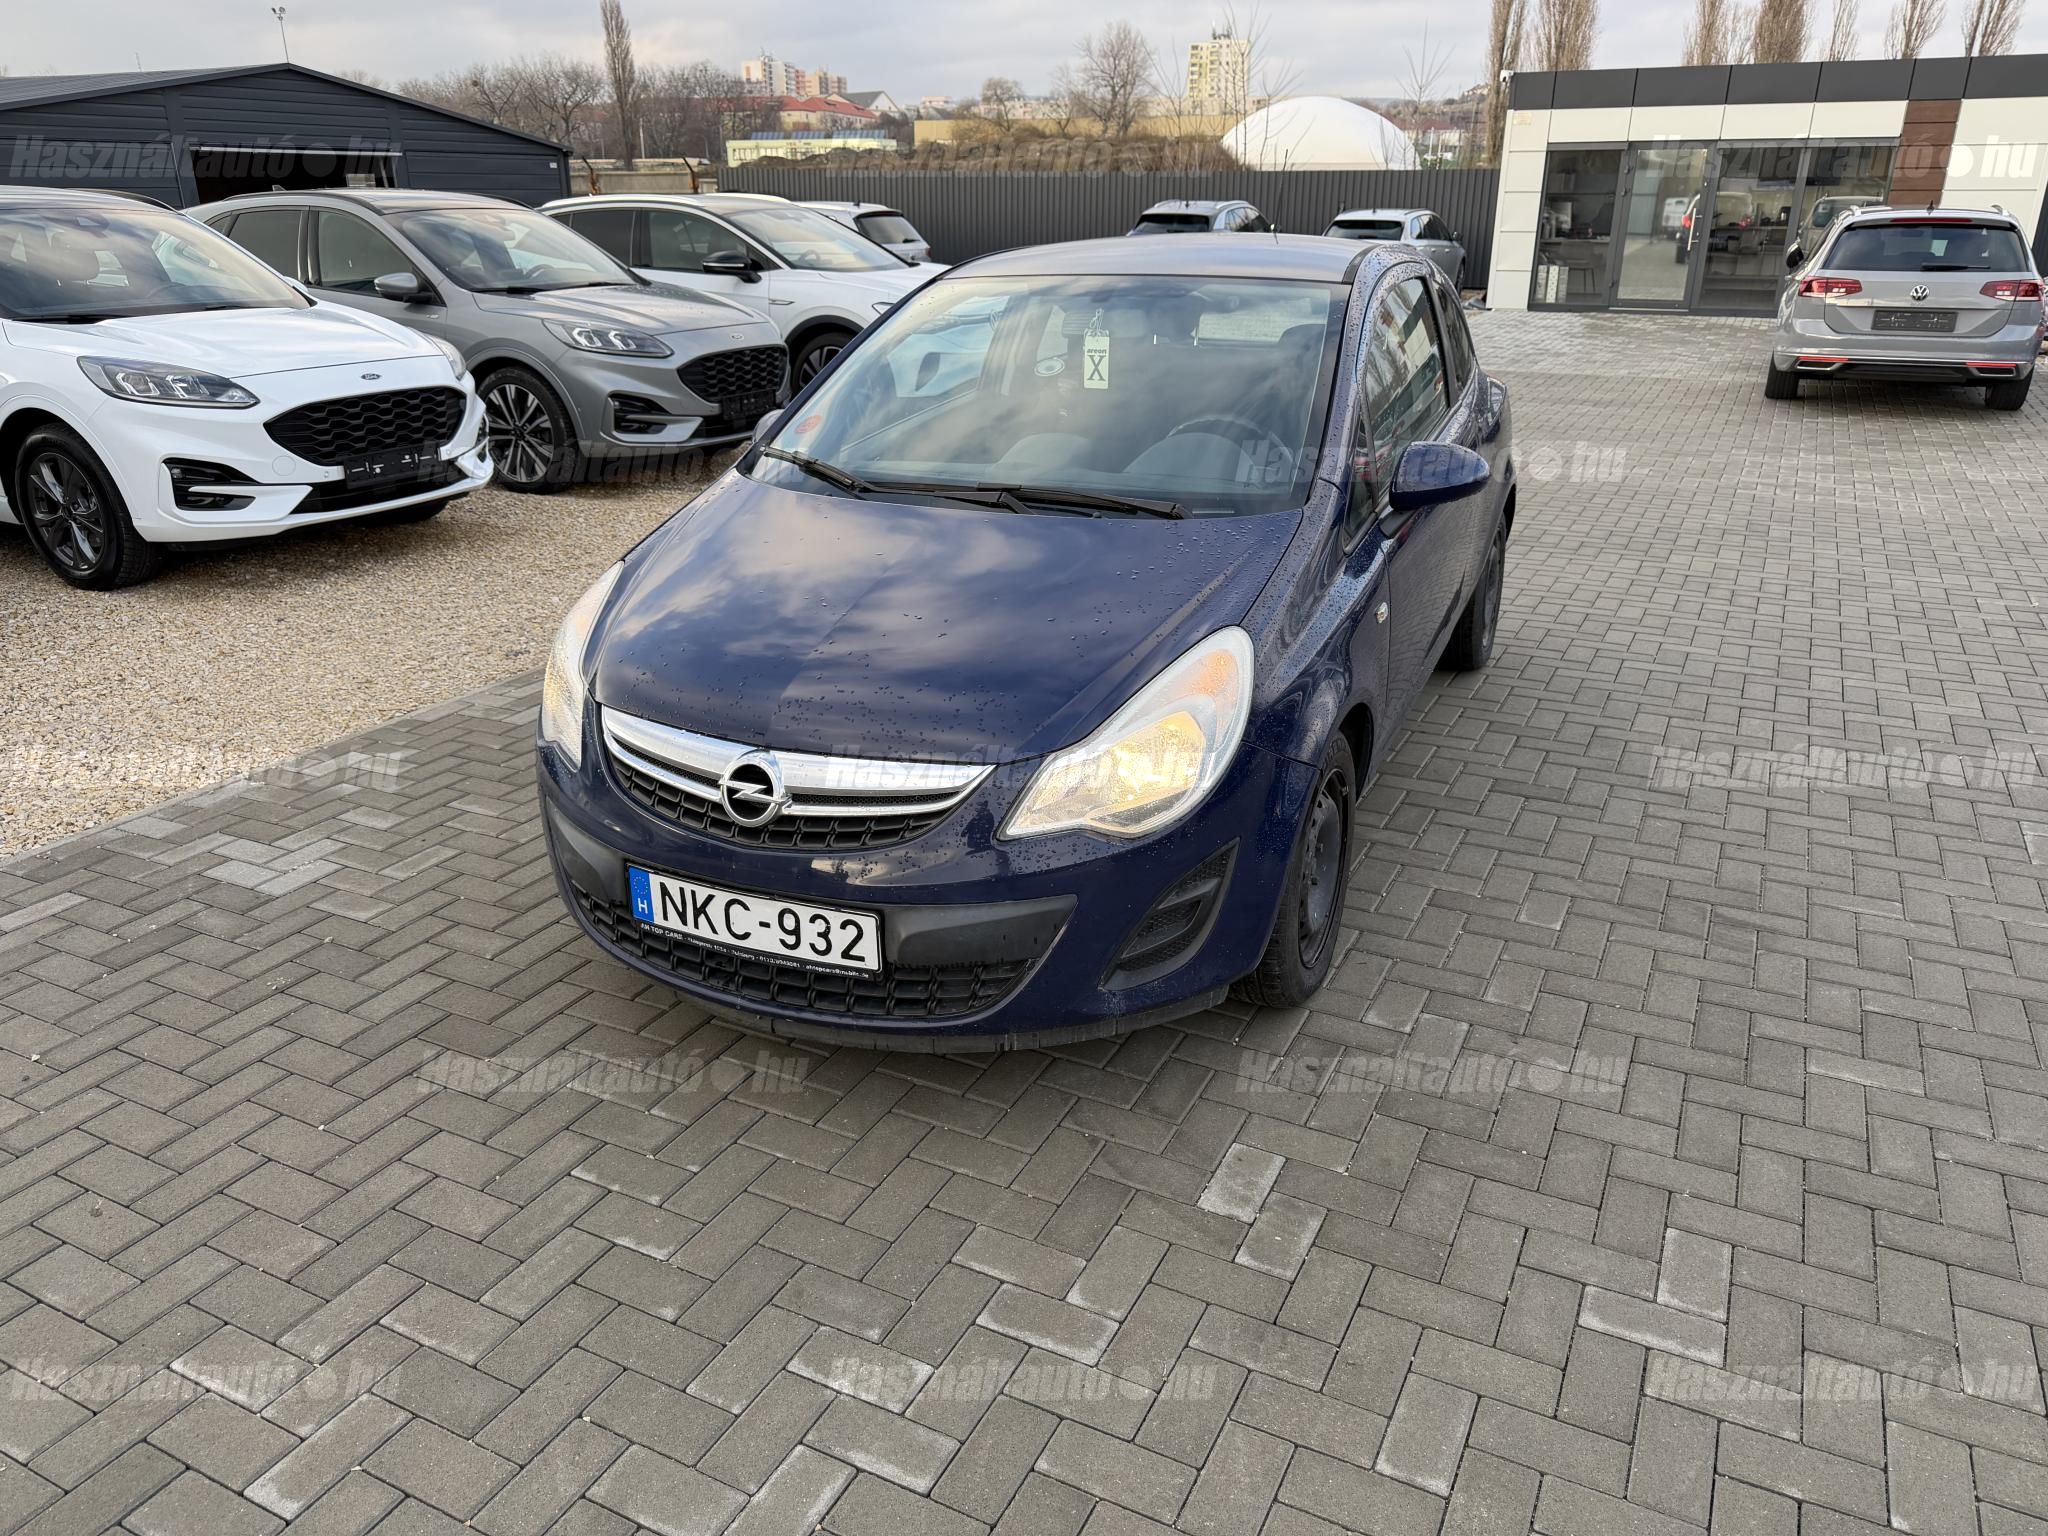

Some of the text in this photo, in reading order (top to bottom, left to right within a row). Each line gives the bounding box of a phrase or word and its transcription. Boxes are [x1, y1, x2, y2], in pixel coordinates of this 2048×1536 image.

[1086, 354, 1107, 381] X
[637, 897, 648, 914] H
[651, 926, 664, 935] TOP
[659, 881, 866, 963] NKC-932
